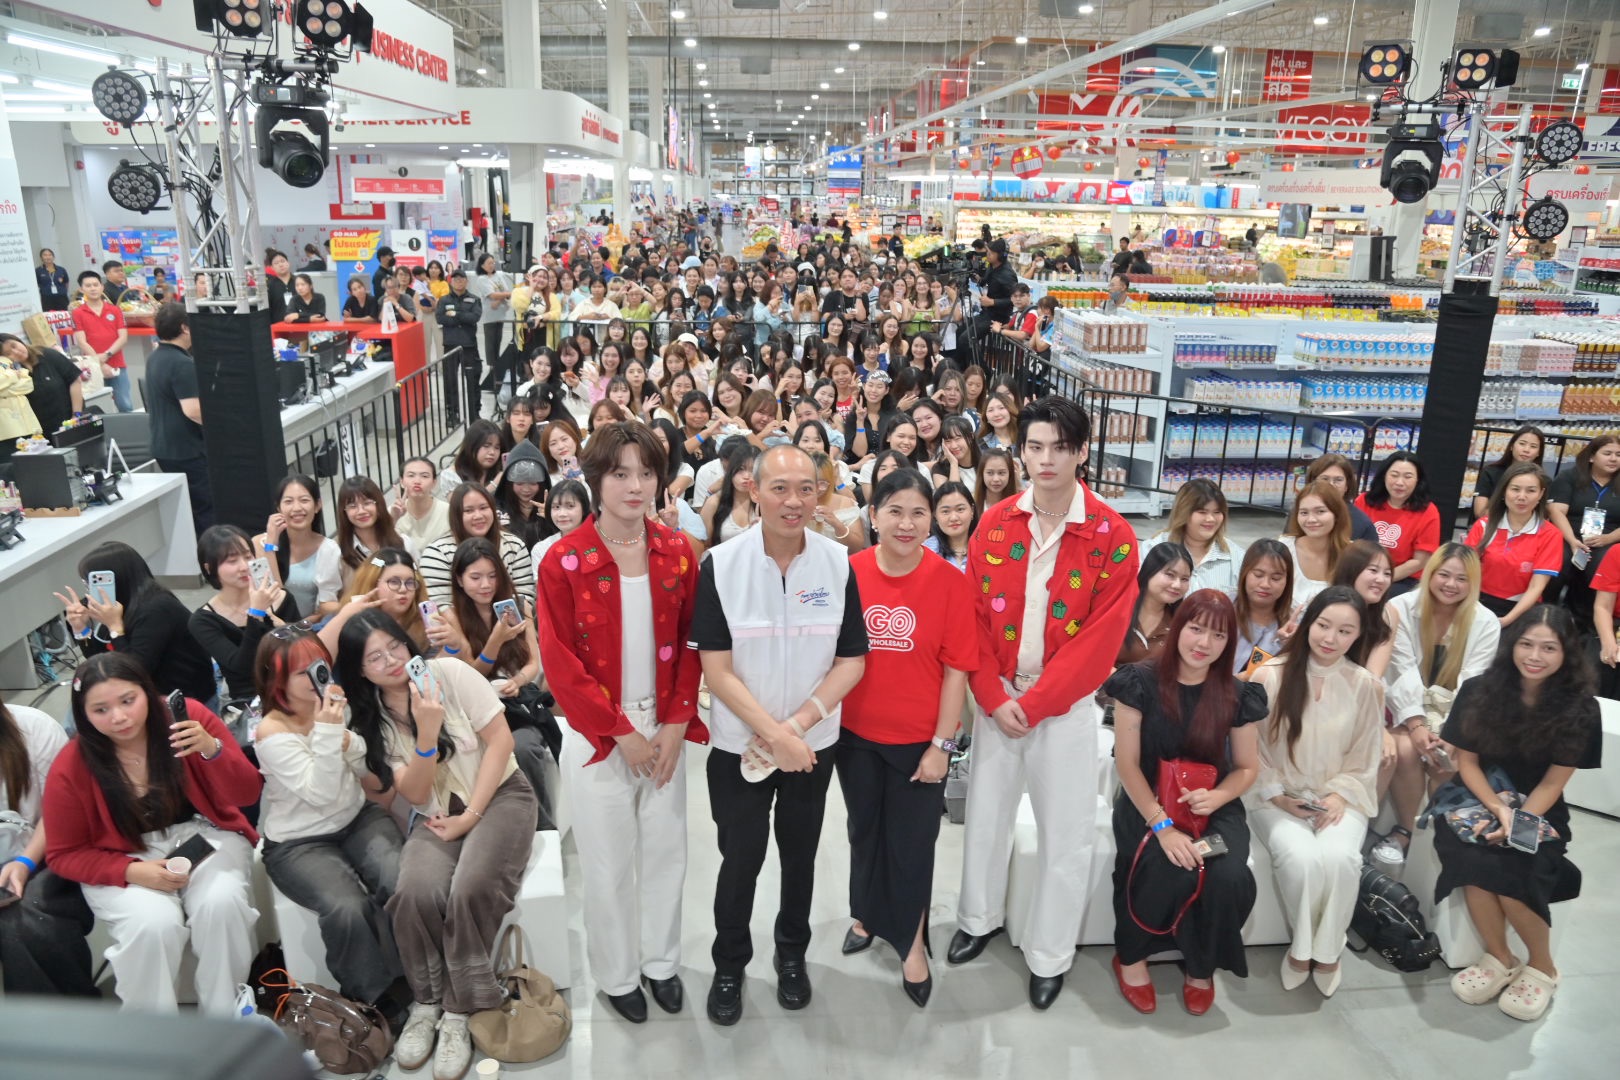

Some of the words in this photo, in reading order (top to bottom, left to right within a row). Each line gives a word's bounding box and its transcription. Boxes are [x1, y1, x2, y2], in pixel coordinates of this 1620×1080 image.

[370, 28, 415, 71] USINESS
[415, 48, 449, 82] CENTER
[863, 605, 917, 638] GO
[869, 639, 909, 648] WHOLESALE
